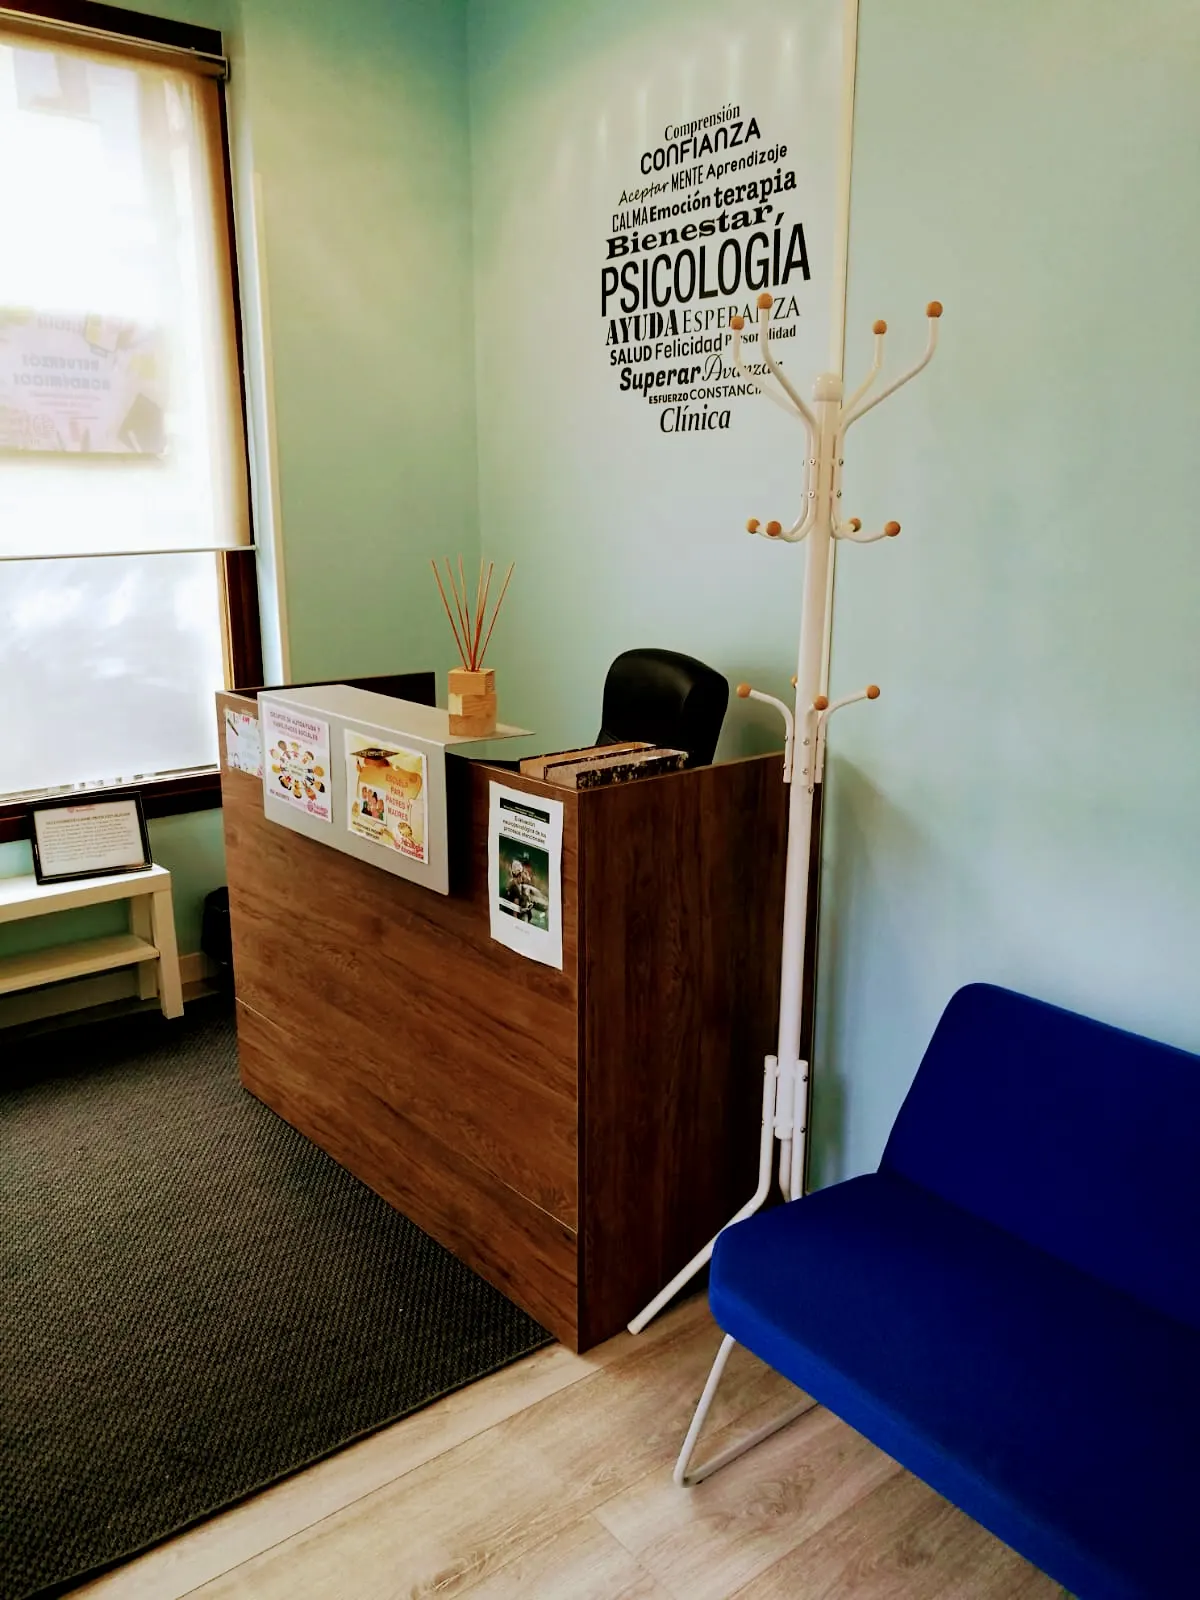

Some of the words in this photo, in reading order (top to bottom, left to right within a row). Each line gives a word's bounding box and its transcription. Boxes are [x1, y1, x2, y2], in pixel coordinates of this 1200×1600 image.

[664, 103, 741, 142] Comprensión
[618, 181, 669, 206] Aceptar
[671, 165, 704, 192] MENTE
[706, 144, 788, 180] Aprendizaje
[612, 206, 649, 233] CALMA
[649, 190, 711, 222] Emoción
[714, 168, 797, 209] terapia
[606, 204, 774, 260] Bienestar
[601, 212, 811, 317] PSICOLOGÍA
[605, 309, 679, 346] AYUDA
[610, 345, 652, 366] SALUD
[655, 333, 722, 360] Felicidad
[620, 367, 702, 398] Superar
[649, 392, 688, 404] ESFUERZO
[660, 403, 731, 433] Clínica
